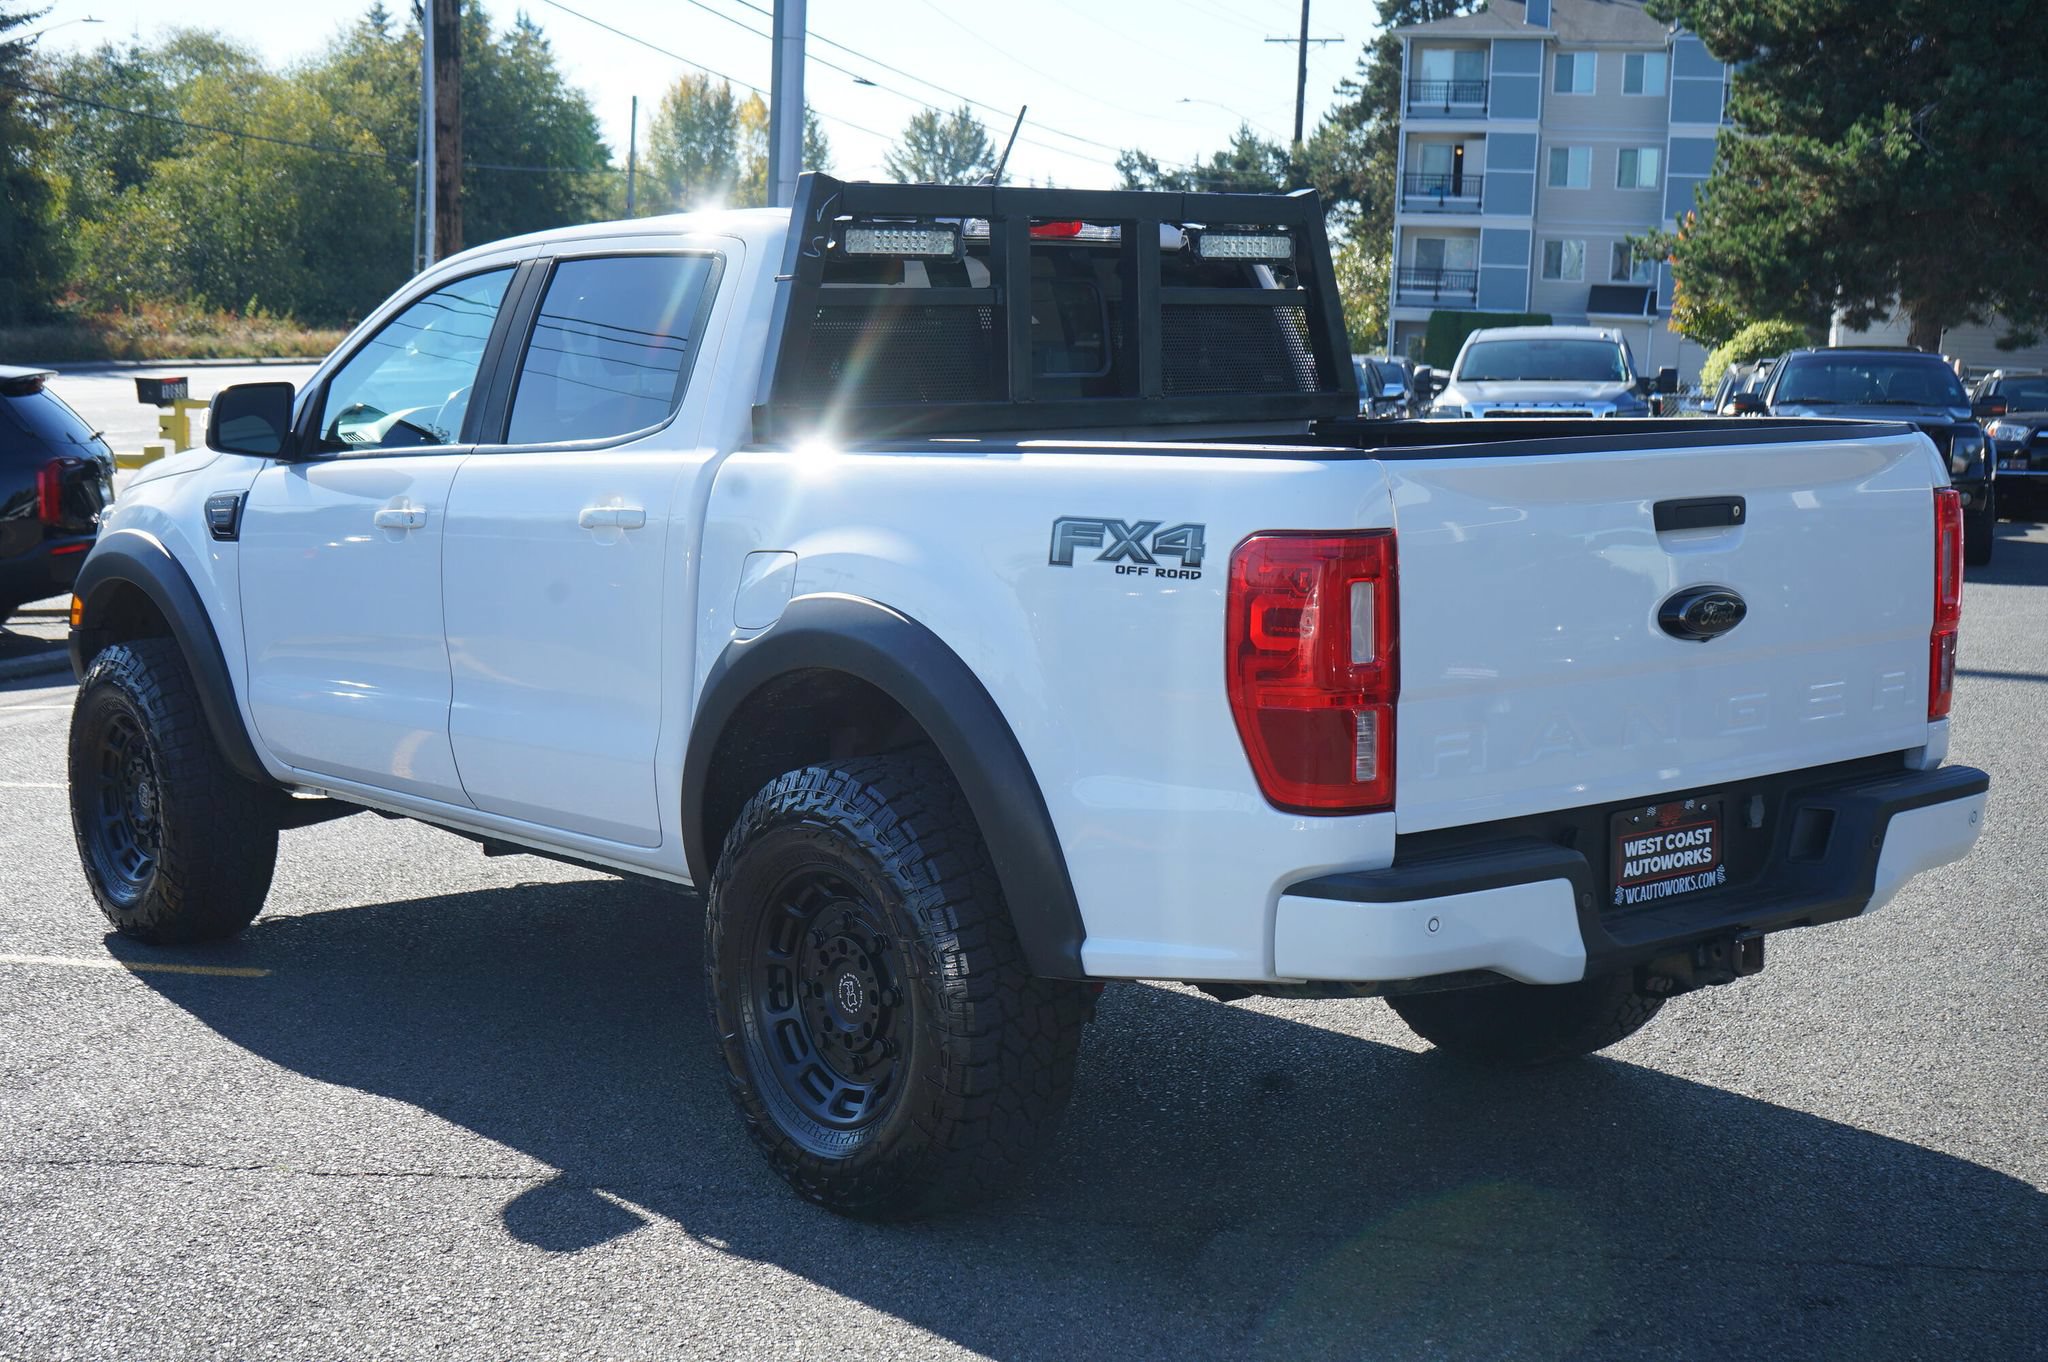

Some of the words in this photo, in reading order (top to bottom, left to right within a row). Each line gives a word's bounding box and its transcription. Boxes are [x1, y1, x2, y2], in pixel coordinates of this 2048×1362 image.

[1048, 515, 1207, 568] FX4
[1115, 565, 1149, 576] OFF
[1155, 568, 1202, 580] ROAD
[1700, 600, 1737, 625] Ford
[1418, 671, 1916, 778] RANGER
[1625, 837, 1664, 857] WEST
[1666, 828, 1712, 850] COAST
[1624, 848, 1712, 877] AUTOWORKS
[1626, 872, 1716, 904] WCAUTOWORKS.COM
